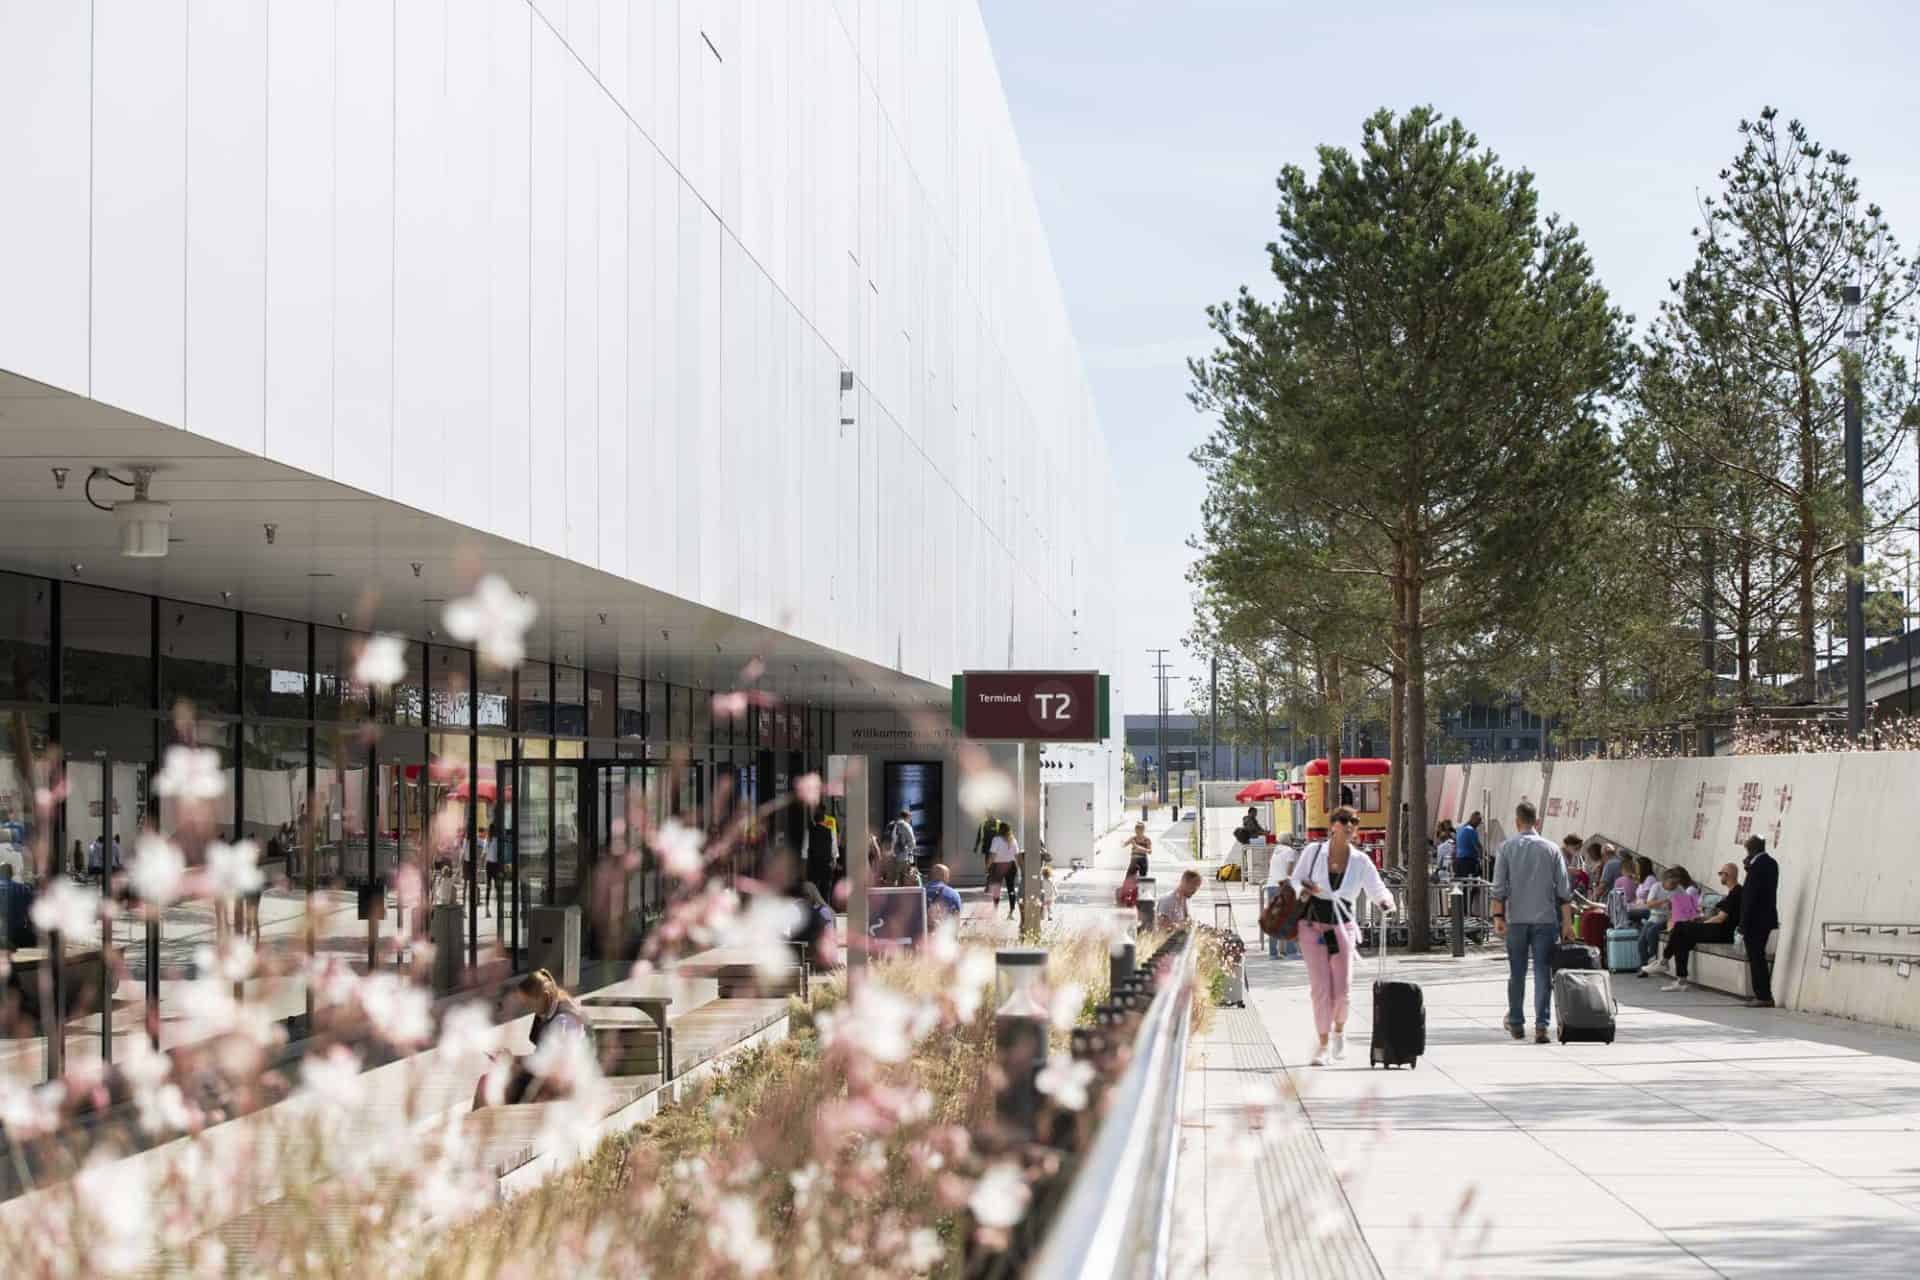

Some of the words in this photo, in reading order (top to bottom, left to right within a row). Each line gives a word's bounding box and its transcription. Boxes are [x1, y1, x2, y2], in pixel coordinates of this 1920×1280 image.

[979, 693, 1022, 703] Terminal
[1034, 693, 1071, 719] T2
[1277, 770, 1284, 780] S
